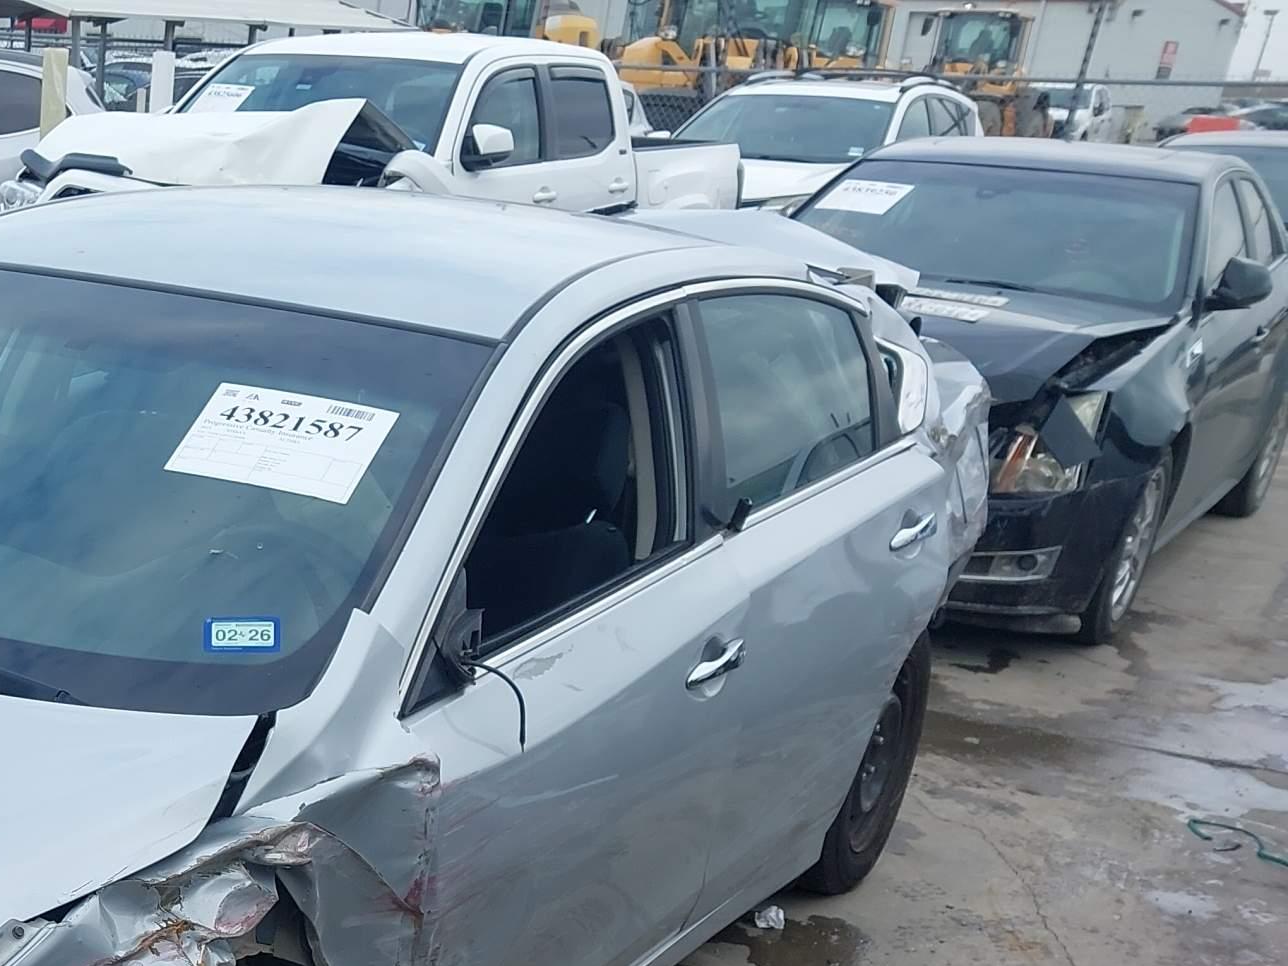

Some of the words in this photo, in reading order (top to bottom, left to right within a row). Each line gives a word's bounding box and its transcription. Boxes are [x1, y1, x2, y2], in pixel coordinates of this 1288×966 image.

[220, 404, 364, 441] 43821587
[215, 629, 238, 641] 02
[248, 629, 271, 641] 26
